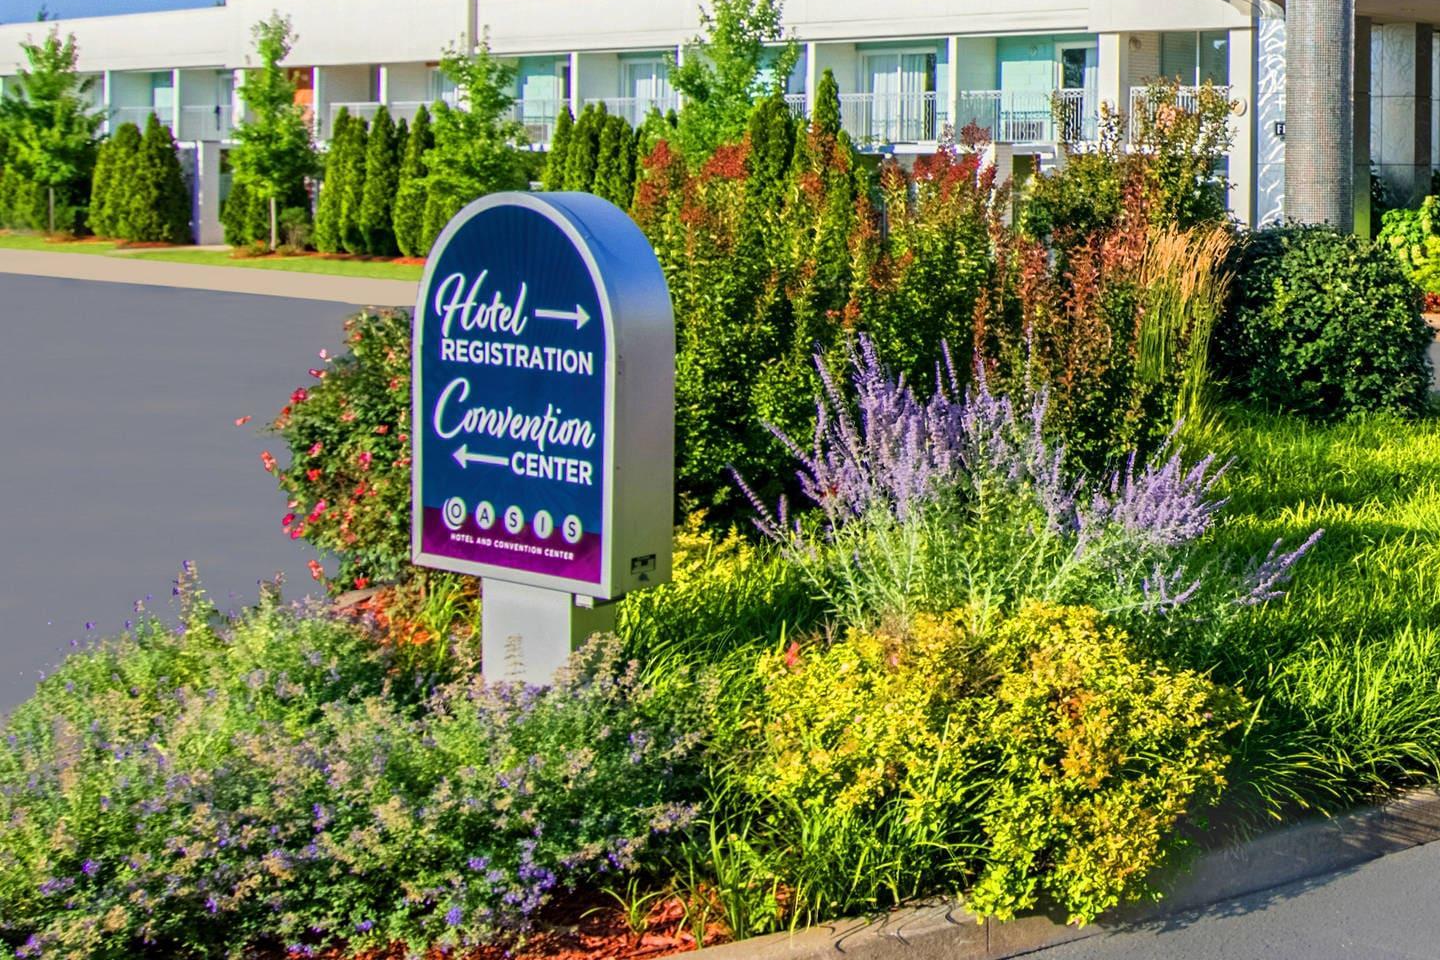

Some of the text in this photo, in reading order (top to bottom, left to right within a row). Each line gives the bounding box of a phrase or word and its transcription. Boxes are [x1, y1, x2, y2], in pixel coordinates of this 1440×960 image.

[435, 269, 527, 338] Hotel
[441, 338, 593, 376] REGISTRATION
[434, 377, 596, 452] Convention
[511, 451, 593, 486] CENTER
[450, 503, 577, 538] OASIS
[450, 533, 575, 561] HOTEL AND CONVENTION CENTER
